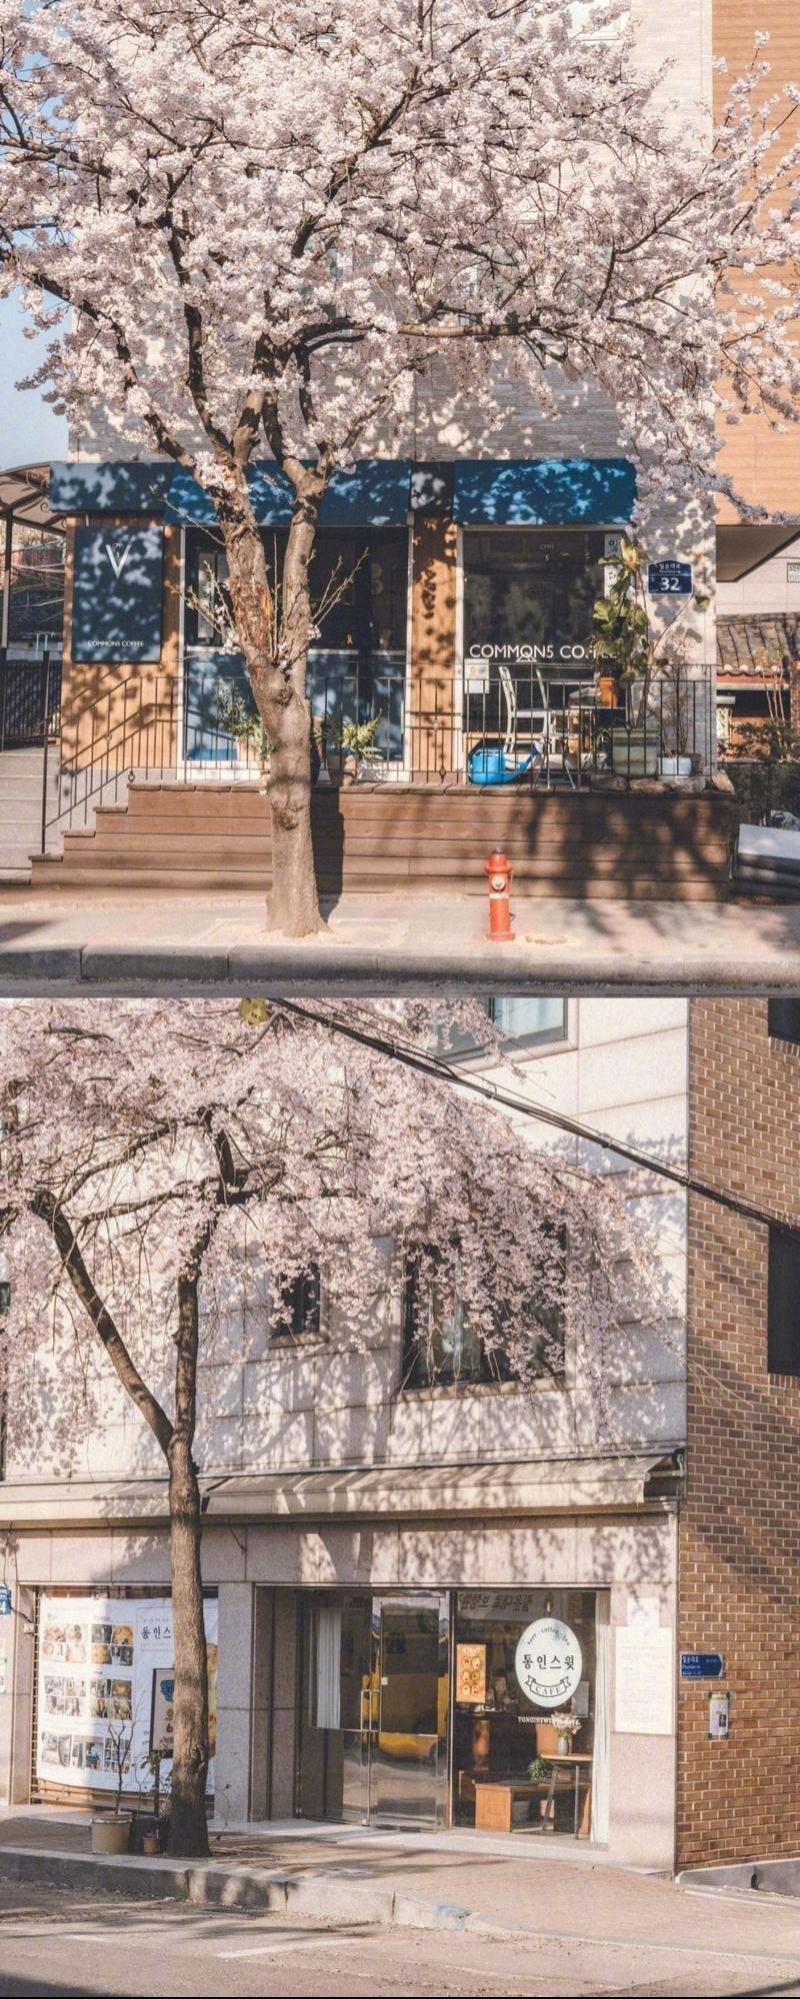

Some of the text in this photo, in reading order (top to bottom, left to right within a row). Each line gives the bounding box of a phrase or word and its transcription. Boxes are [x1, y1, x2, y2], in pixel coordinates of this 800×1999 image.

[661, 577, 680, 591] 32
[141, 1625, 171, 1640] 통인스
[522, 1654, 574, 1671] 통인스윗
